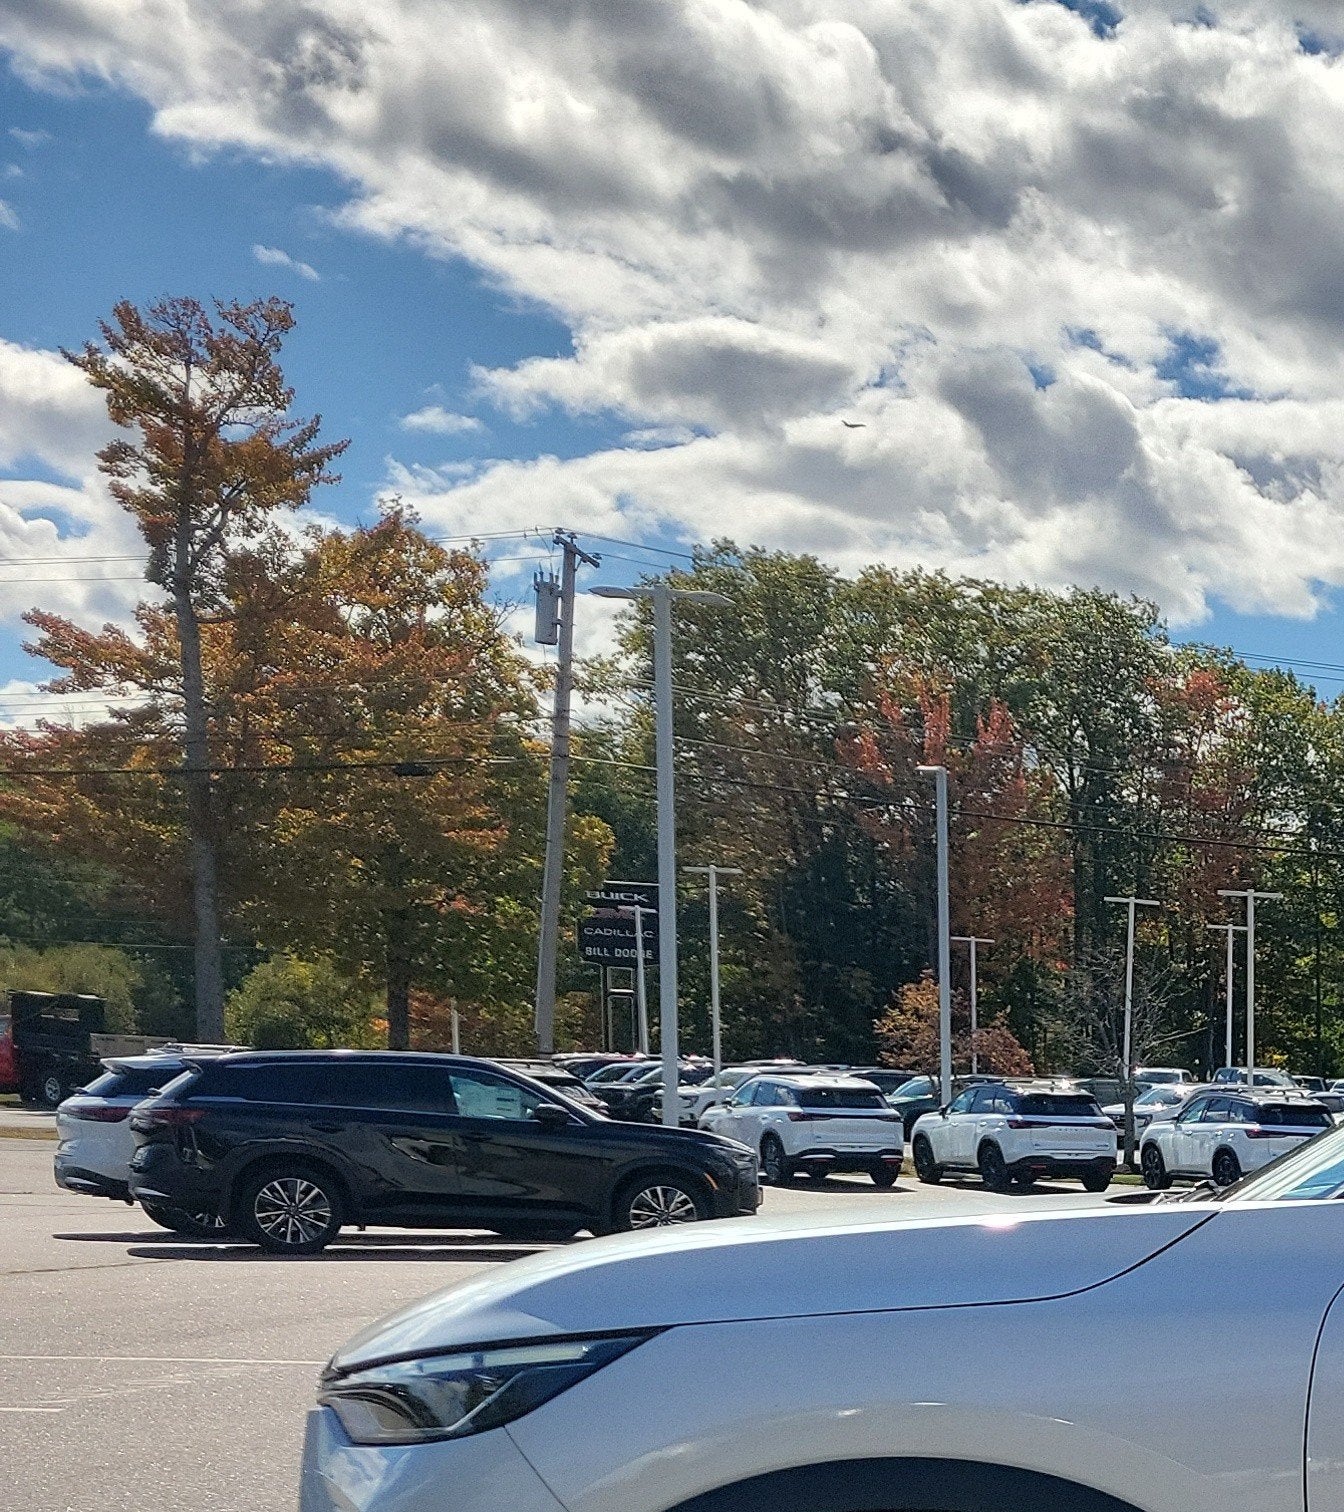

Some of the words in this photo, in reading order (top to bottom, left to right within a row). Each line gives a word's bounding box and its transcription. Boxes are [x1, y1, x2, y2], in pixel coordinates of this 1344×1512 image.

[585, 891, 649, 903] BUICK
[585, 947, 609, 957] BILL
[614, 947, 654, 959] DODE
